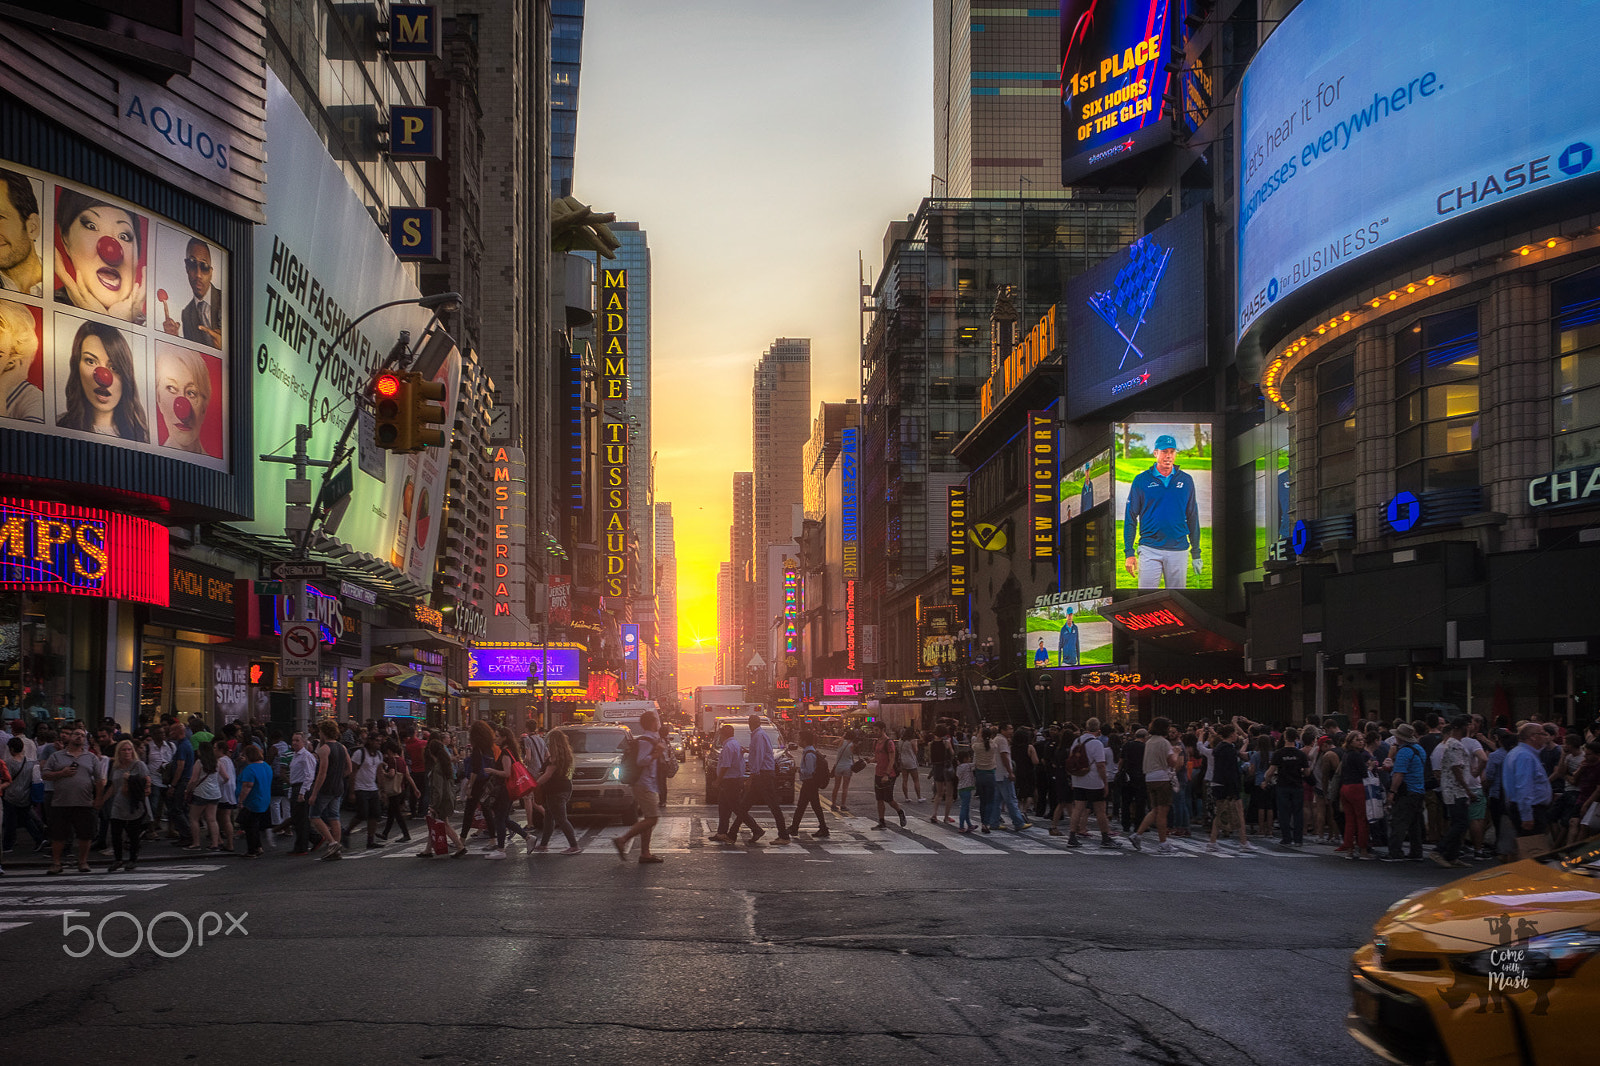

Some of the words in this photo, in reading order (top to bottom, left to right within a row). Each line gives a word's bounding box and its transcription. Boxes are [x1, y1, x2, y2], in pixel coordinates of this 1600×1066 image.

[1070, 71, 1097, 97] 1ST
[1100, 35, 1161, 85] PLACE
[1077, 122, 1094, 143] OF
[1094, 110, 1119, 135] THE
[1120, 96, 1153, 123] GLEN
[1082, 97, 1104, 121] SIX
[1105, 78, 1147, 111] HOURS
[126, 95, 228, 170] AQUOS
[1240, 155, 1297, 236] businesses
[1301, 71, 1445, 162] everywhere.
[1245, 146, 1264, 186] Let's
[1266, 112, 1297, 161] hear
[1301, 100, 1312, 128] it
[1317, 75, 1345, 116] for
[1437, 154, 1551, 215] CHASE
[1241, 287, 1266, 330] CHASE
[1280, 273, 1291, 298] for
[1292, 220, 1380, 286] BUSINESS
[270, 234, 309, 307] HIGH
[308, 276, 362, 366] FASHION
[265, 283, 318, 365] THRIFT
[316, 338, 356, 402] STORE
[603, 268, 625, 399] MADAME
[1003, 303, 1056, 397] VICTORY
[269, 358, 291, 389] Calories
[843, 428, 857, 453] NEW
[1034, 416, 1052, 510] VICTORY
[494, 447, 510, 617] AMSTERDAM
[606, 423, 624, 597] TUSSAUD'S
[843, 495, 857, 542] STUDIOS
[951, 489, 965, 556] VICTORY
[844, 546, 857, 573] DUKE
[1035, 516, 1052, 557] NEW
[173, 567, 204, 598] KNOW
[208, 576, 235, 605] GAME
[262, 582, 268, 593] 7
[278, 567, 294, 576] ONE
[549, 584, 571, 598] JERSEY
[951, 562, 965, 597] NEW
[552, 596, 567, 608] BOYS
[785, 571, 798, 653] REGAL
[1034, 586, 1104, 608] SKECHERS
[1115, 608, 1184, 632] Subway
[455, 602, 488, 640] SEPHORA
[216, 668, 233, 683] OWN
[233, 669, 247, 684] THE
[216, 684, 248, 704] STAGE
